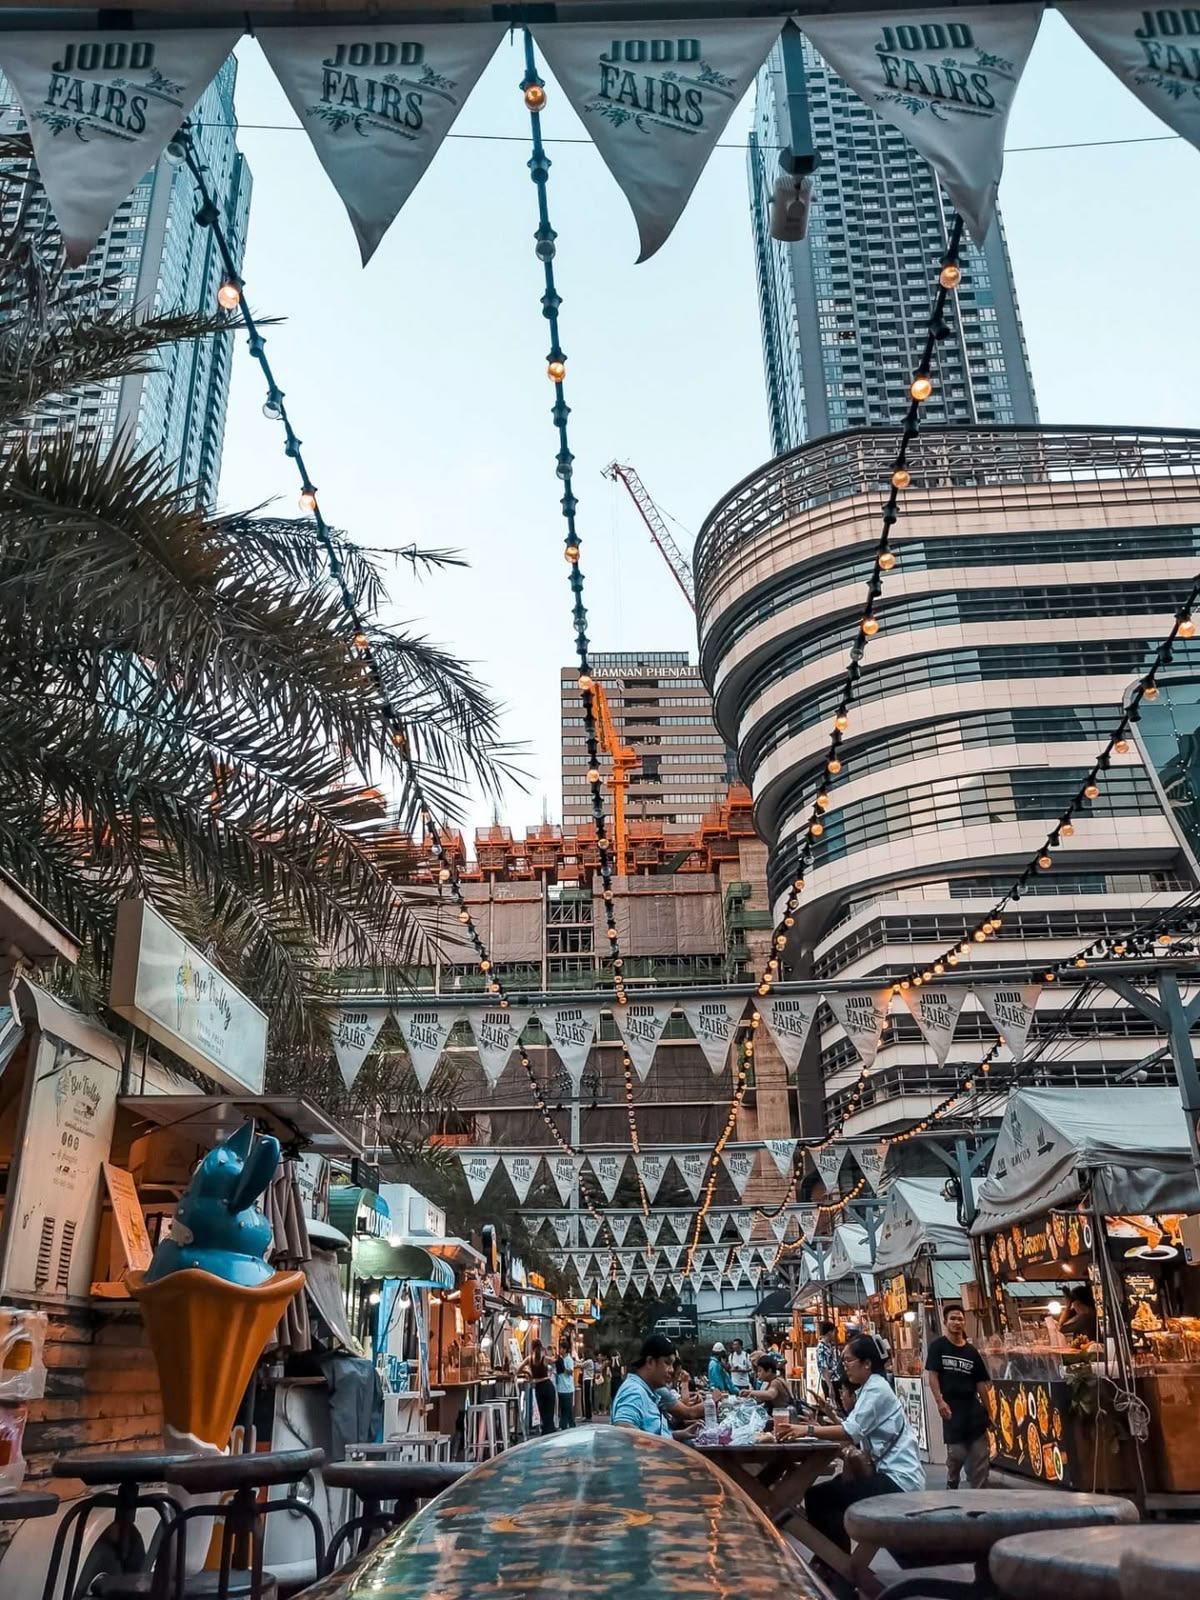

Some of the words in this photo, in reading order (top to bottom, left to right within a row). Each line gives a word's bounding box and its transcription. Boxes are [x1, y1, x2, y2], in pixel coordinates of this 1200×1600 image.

[1135, 9, 1200, 38] JOD
[875, 22, 973, 53] JODD
[51, 42, 155, 72] JODD
[322, 42, 425, 68] JODD
[601, 39, 700, 63] JODD
[1136, 40, 1200, 82] FAI
[875, 53, 996, 109] FAIRS
[43, 73, 150, 135] FAIRS
[320, 68, 425, 131] FAIRS
[599, 64, 705, 127] FAIRS
[590, 667, 642, 677] HAMNAN
[646, 667, 697, 678] PHENJATI
[772, 1001, 799, 1012] JODD
[845, 997, 873, 1009] JODD
[920, 994, 947, 1004] JODD
[994, 992, 1021, 1003] JODD
[341, 1012, 367, 1024] JODD
[409, 1012, 438, 1024] JODD
[482, 1013, 510, 1024] JODD
[557, 1010, 582, 1021] JODD
[627, 1006, 654, 1017] JODD
[699, 1004, 726, 1015] JODD
[846, 1009, 877, 1030] FAIRS
[920, 1004, 951, 1026] FAIRS
[994, 1003, 1023, 1025] FAIRS
[556, 1021, 585, 1043] FAIRS
[626, 1017, 655, 1040] FAIRS
[699, 1015, 729, 1037] FAIRS
[773, 1012, 803, 1034] FAIRS
[338, 1023, 366, 1046] FAIRS
[410, 1024, 438, 1046] FAIRS
[481, 1024, 509, 1046] FAIRS
